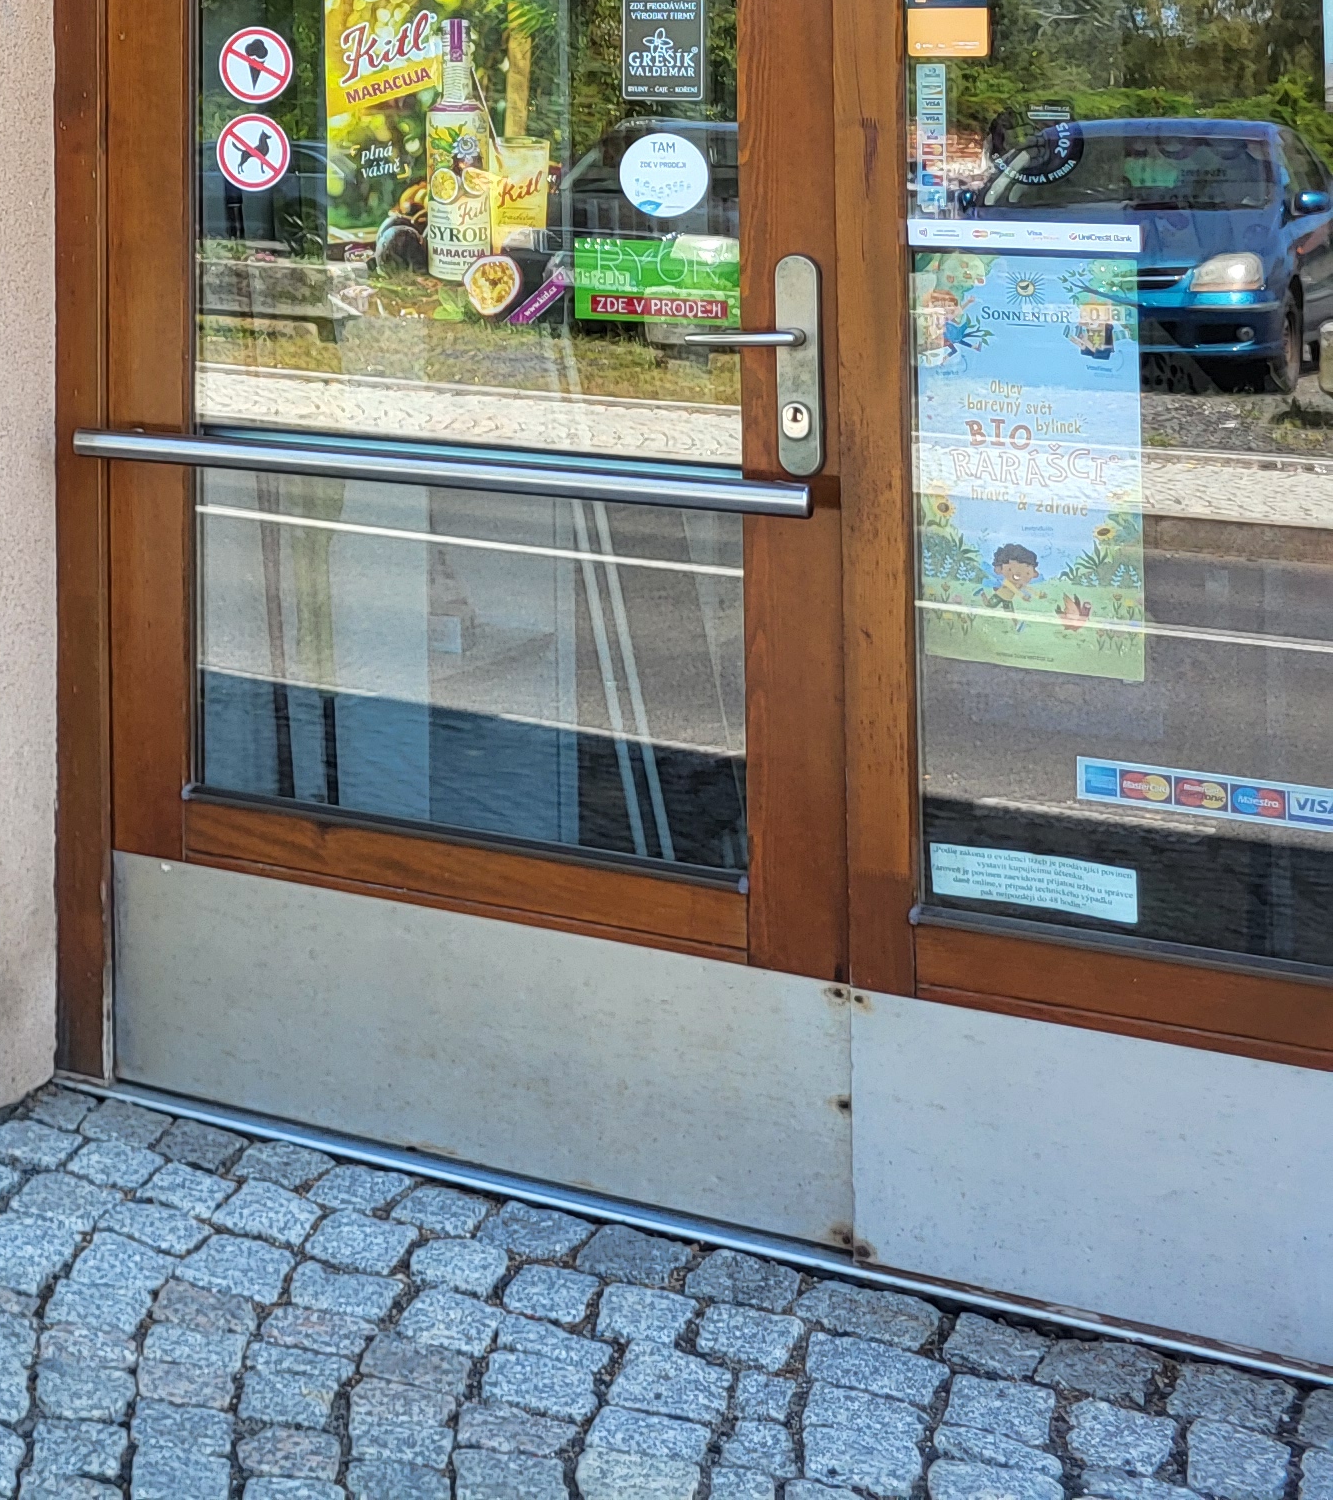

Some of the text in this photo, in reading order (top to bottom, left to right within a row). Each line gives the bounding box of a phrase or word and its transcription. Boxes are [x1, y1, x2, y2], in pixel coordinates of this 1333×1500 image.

[629, 1, 697, 10] ZDE PRODÁVÁME
[631, 11, 696, 20] VÝROBKY FIRMY
[340, 9, 431, 87] Kitl
[628, 49, 696, 67] GREŠÍK
[629, 66, 696, 77] VALDEMAR
[345, 67, 432, 104] MARACUJA
[650, 141, 676, 153] TAM
[1054, 122, 1071, 158] 2015
[360, 142, 394, 162] plná
[361, 160, 401, 179] vášně
[991, 152, 1076, 183] SPOLEHLIVÁ FIRMA
[497, 170, 543, 208] Kitl
[433, 246, 486, 258] MARACUJA
[596, 297, 722, 318] ZDE V PRODEJI
[981, 306, 1071, 323] SONNENTOR
[990, 380, 1023, 398] Objev
[967, 394, 1053, 416] barevný svět
[965, 418, 1032, 450] BIO
[1035, 417, 1082, 435] bylinek
[950, 443, 1107, 487] RARÁŠCI
[1237, 795, 1279, 808] Maestro
